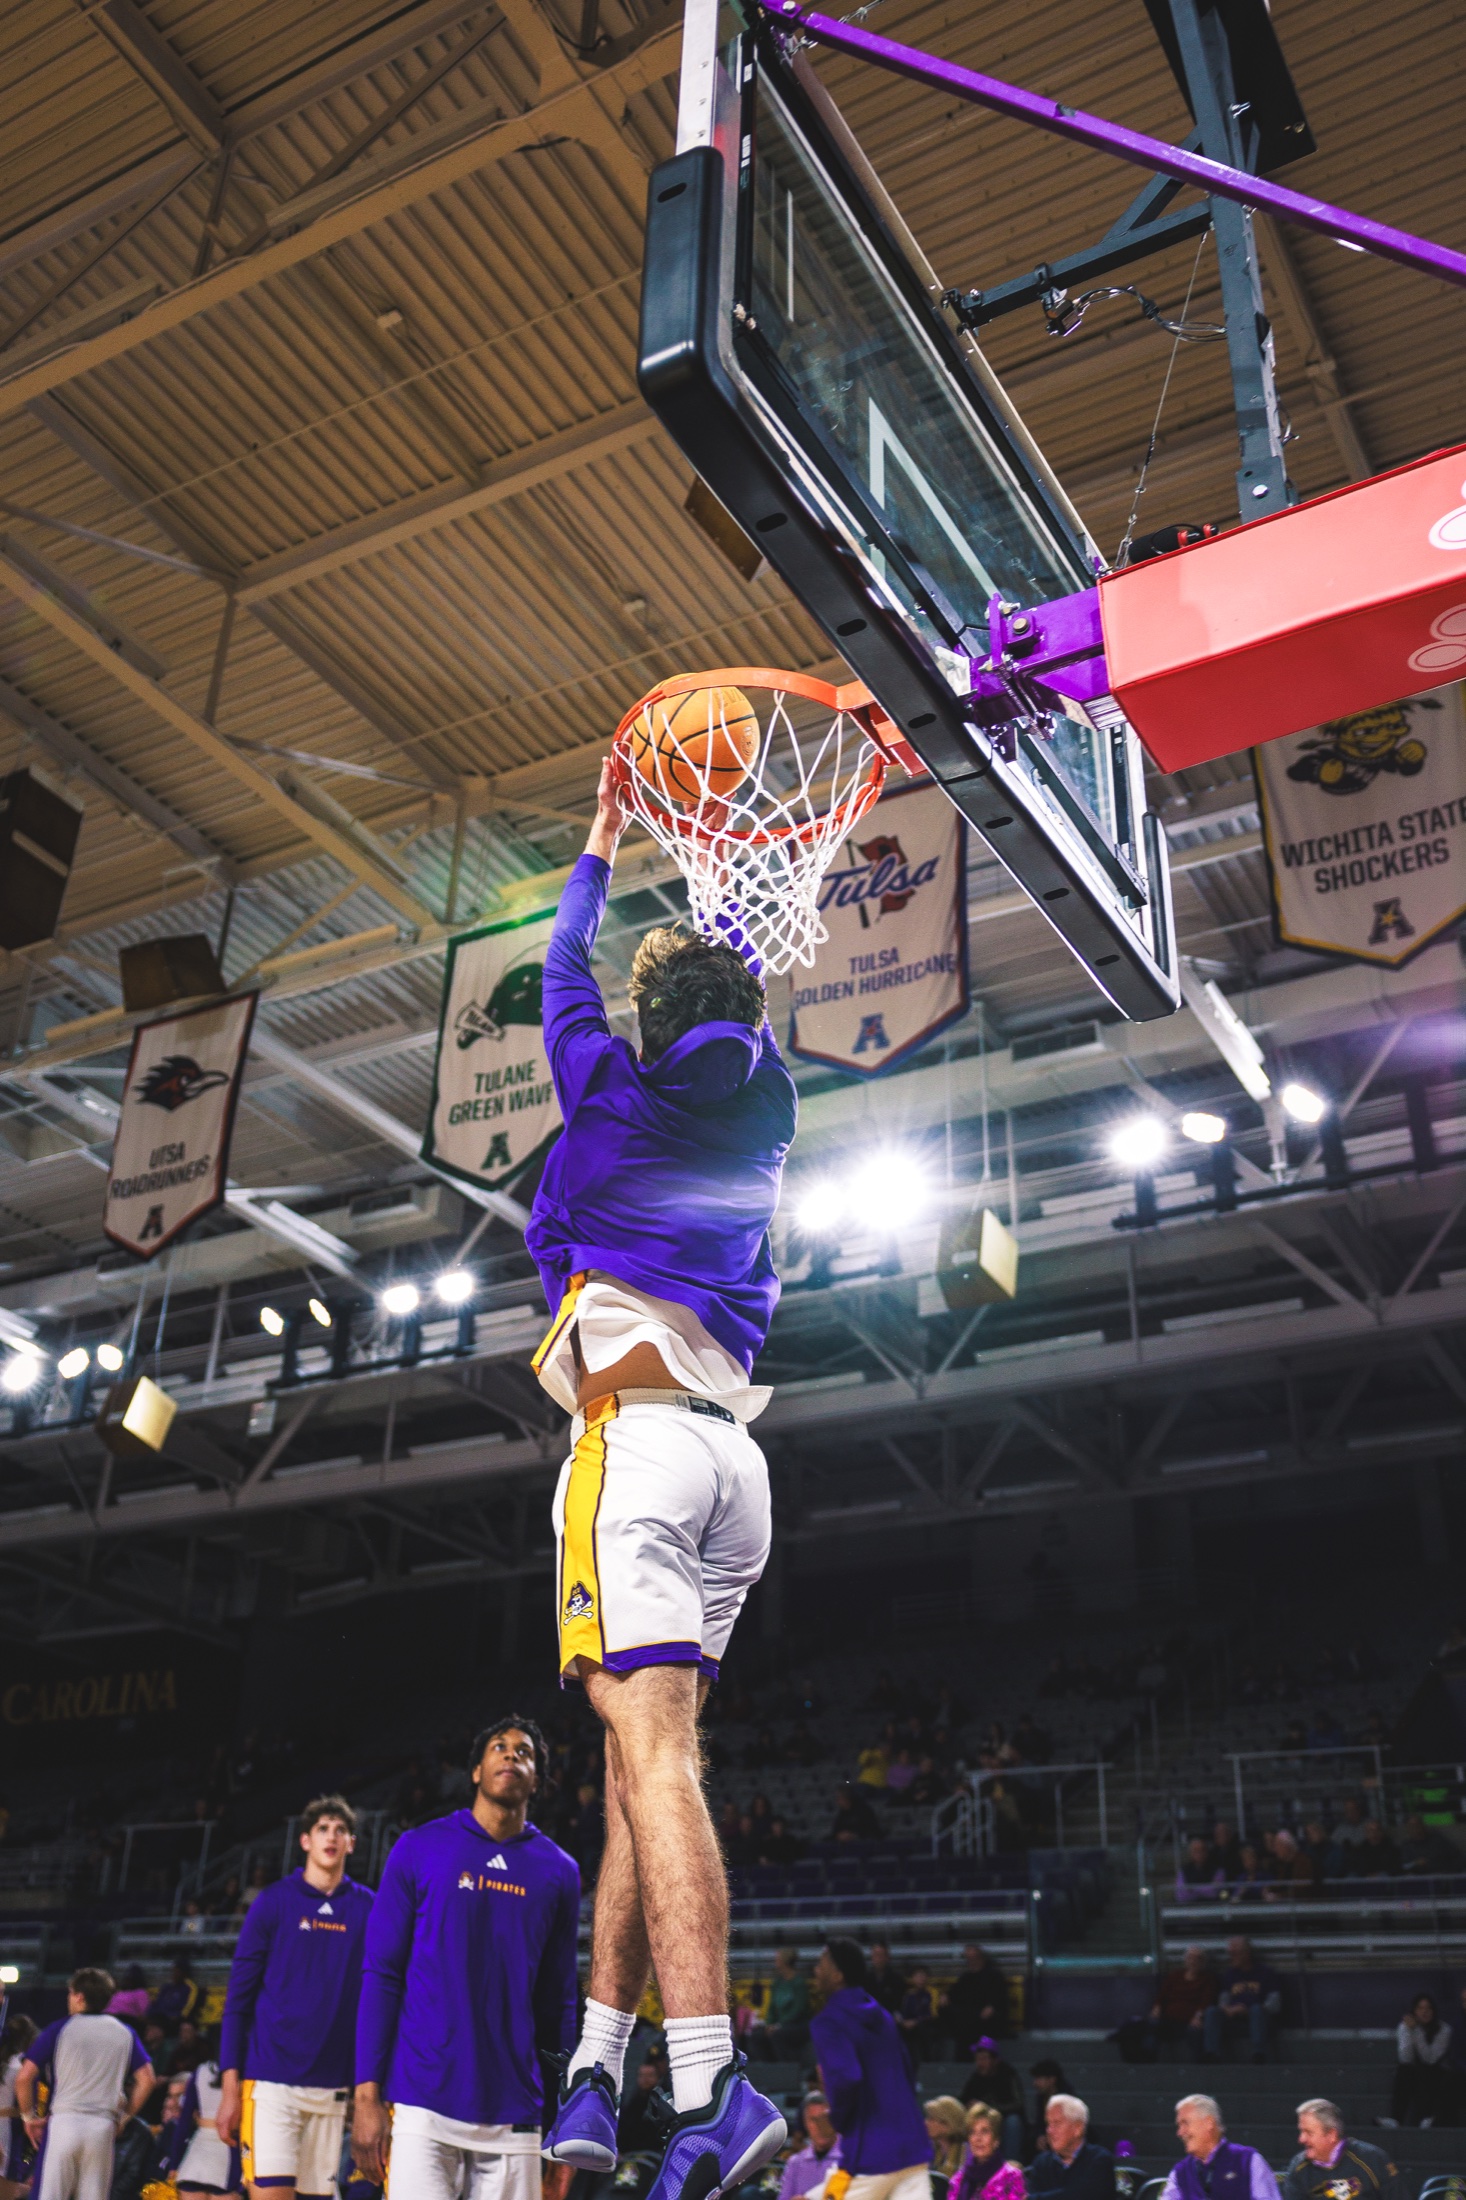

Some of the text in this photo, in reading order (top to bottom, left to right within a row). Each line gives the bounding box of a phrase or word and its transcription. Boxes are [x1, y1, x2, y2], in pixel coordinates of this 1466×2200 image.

[1280, 821, 1394, 868] WICHITA
[1314, 837, 1450, 893] SHOCKERS
[817, 852, 940, 912] Tulsa
[848, 947, 900, 976] TULSA
[859, 952, 957, 995] HURRICANE
[474, 1059, 537, 1095] TULANE
[449, 1094, 505, 1125] GREEN
[2, 1670, 177, 1726] CAROLINA
